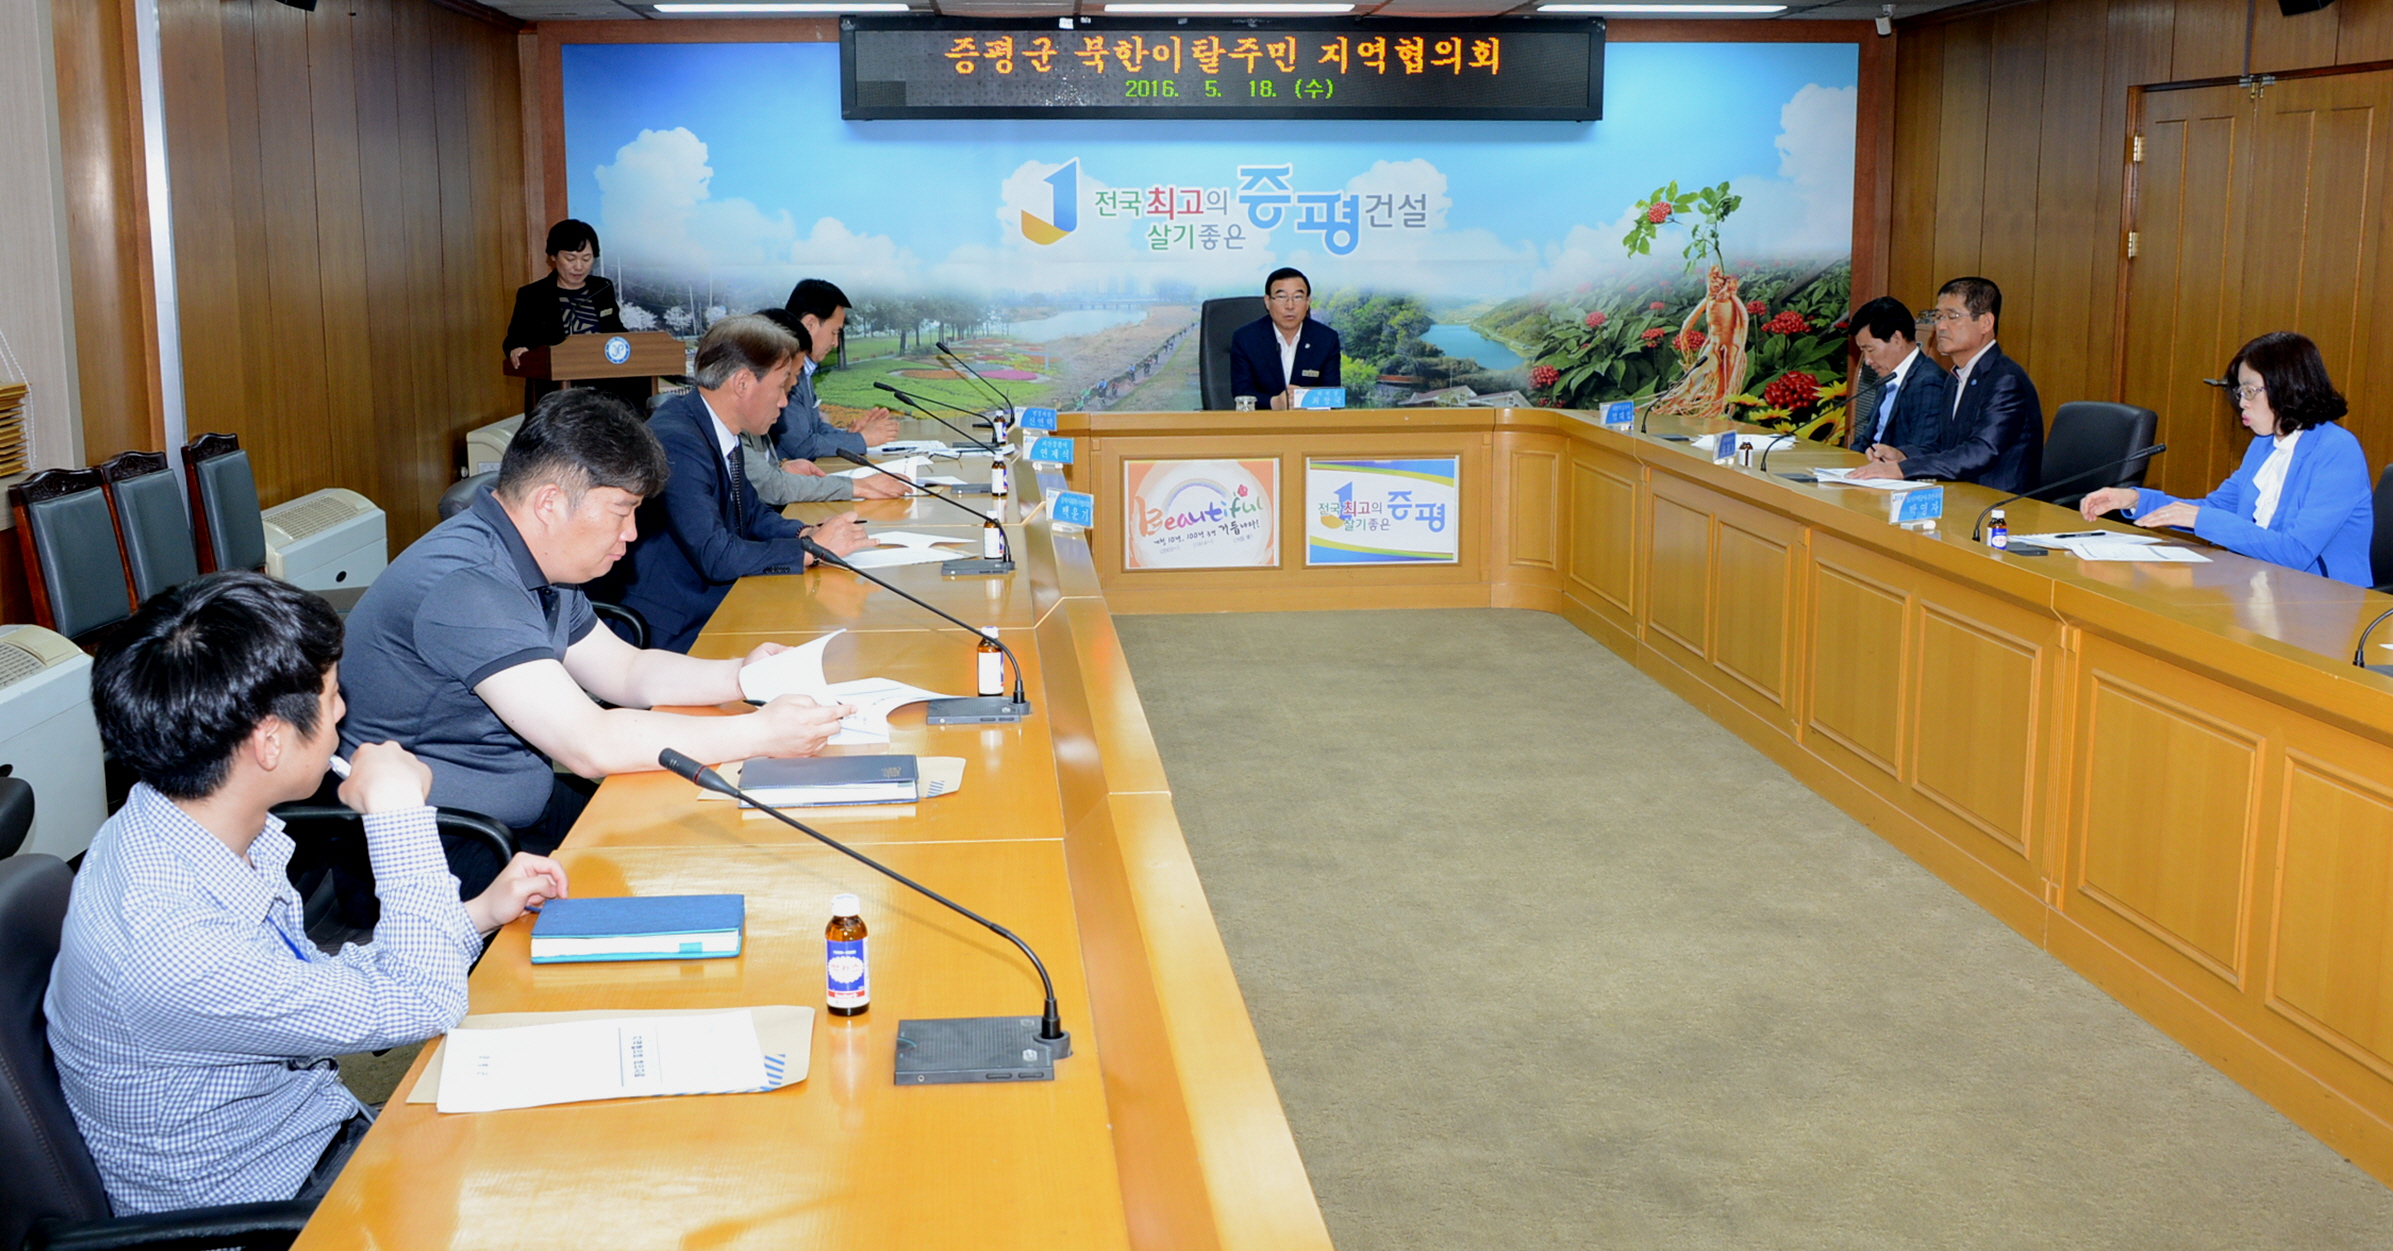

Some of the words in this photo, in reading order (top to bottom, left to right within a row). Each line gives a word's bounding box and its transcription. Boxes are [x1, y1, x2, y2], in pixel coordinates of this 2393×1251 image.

[944, 36, 1057, 74] 증평군
[1074, 36, 1296, 74] 북한이탈주민
[1318, 36, 1500, 75] 지역협의회
[1125, 80, 1179, 98] 2016.
[1205, 80, 1221, 98] 5.
[1249, 80, 1276, 98] 18.
[1295, 78, 1333, 99] (수)
[1134, 491, 1263, 537] Beautiful
